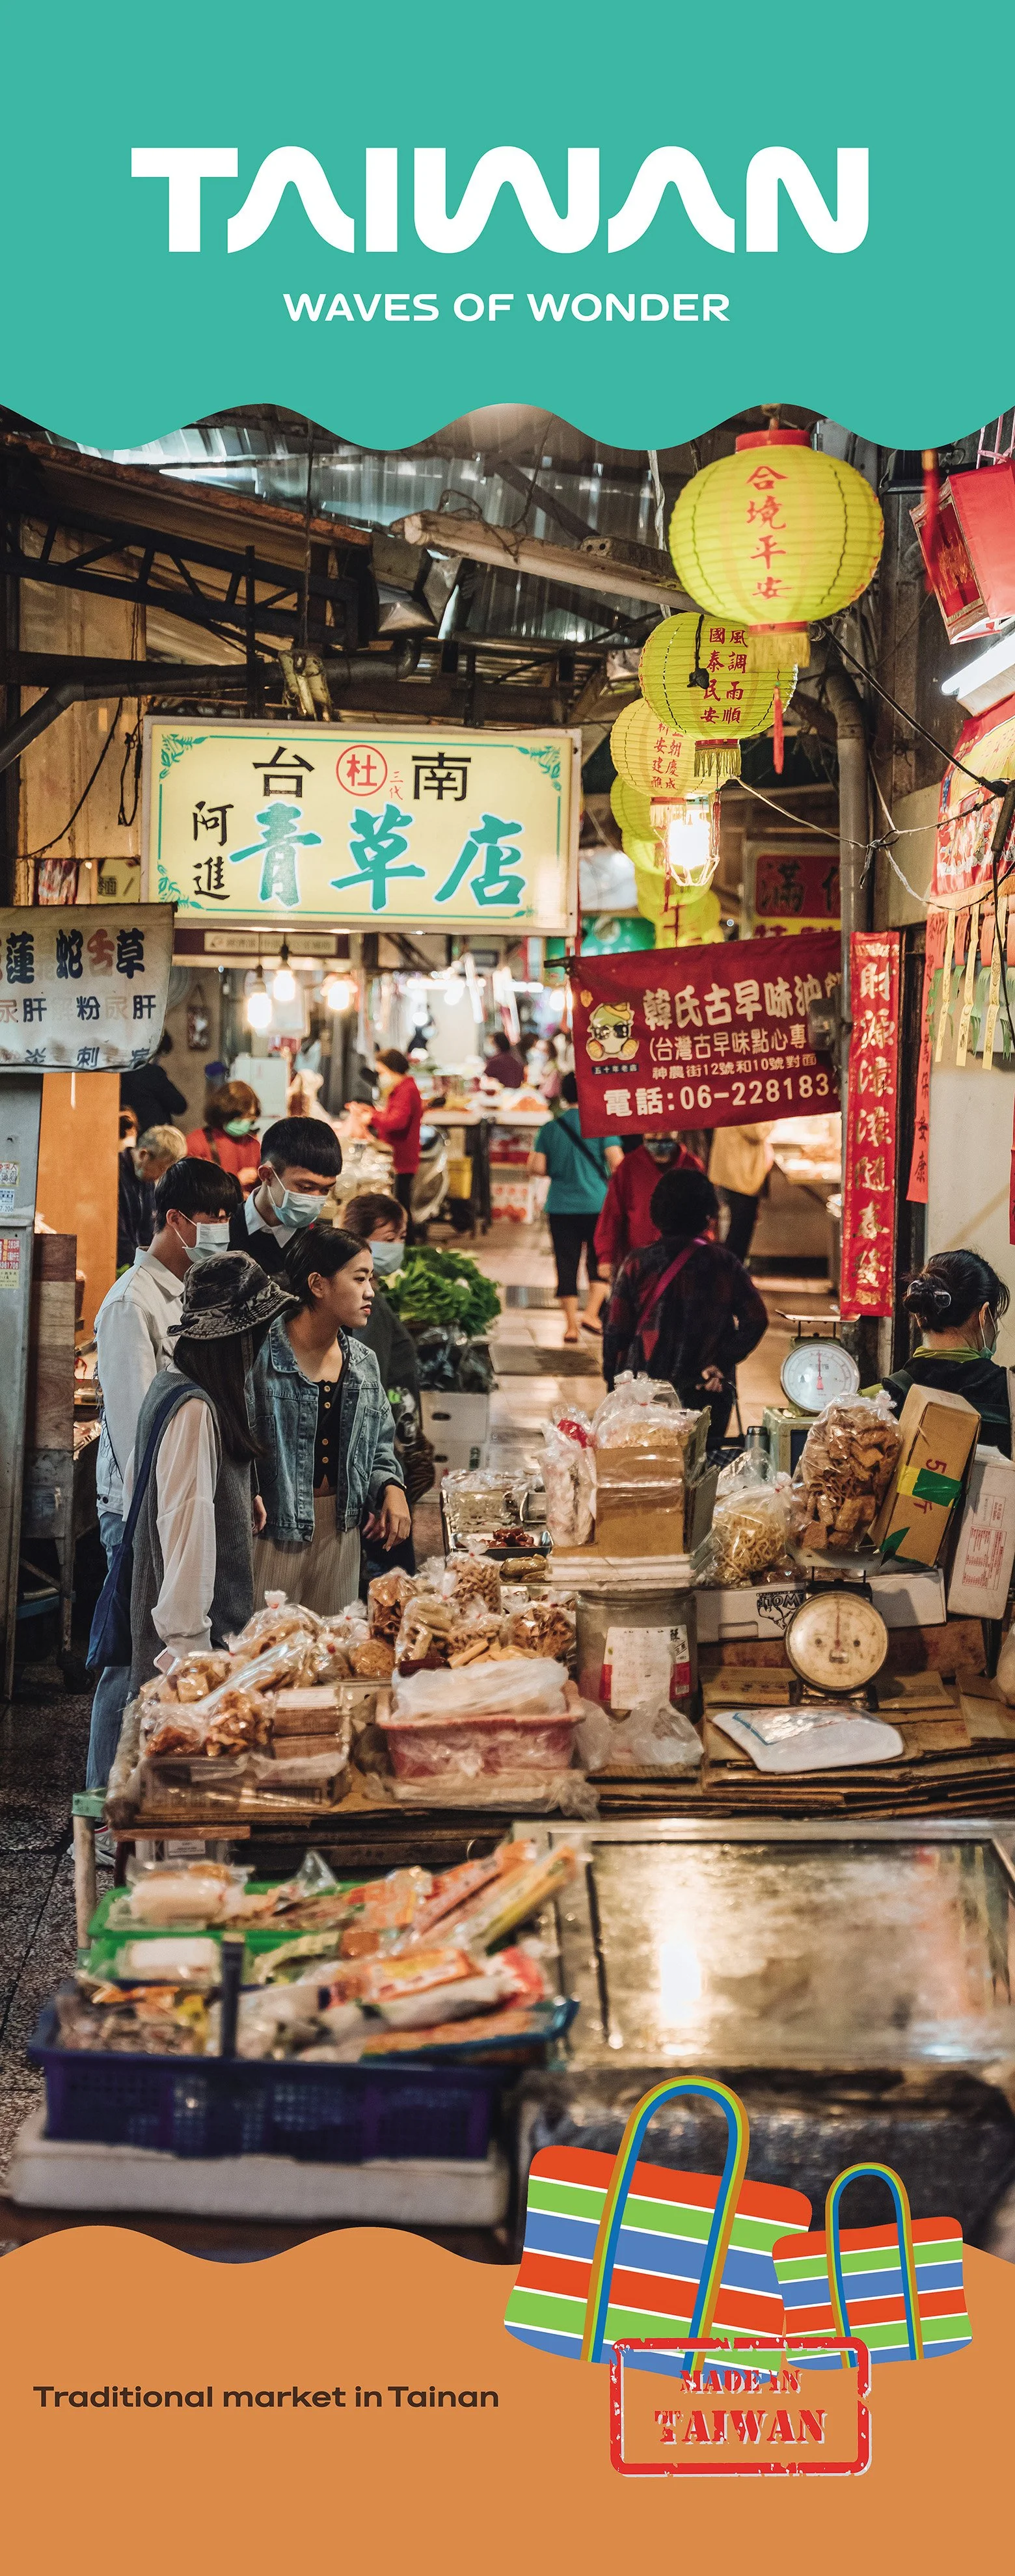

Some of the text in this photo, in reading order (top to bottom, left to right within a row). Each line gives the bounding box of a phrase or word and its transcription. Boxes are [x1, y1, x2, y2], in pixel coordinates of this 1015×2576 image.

[746, 466, 789, 600] 合境平安
[701, 627, 726, 725] 國泰民安
[722, 630, 748, 725] 風調雨順
[253, 746, 472, 801] 台 南
[344, 751, 379, 789] 杜
[389, 771, 404, 801] 三代
[666, 732, 684, 790] 朝慶成
[193, 801, 234, 900] 阿進
[228, 802, 526, 910] 青草店
[602, 1073, 841, 1118] 電話:06-228183
[651, 1053, 817, 1080] 神農街12號和10號對面
